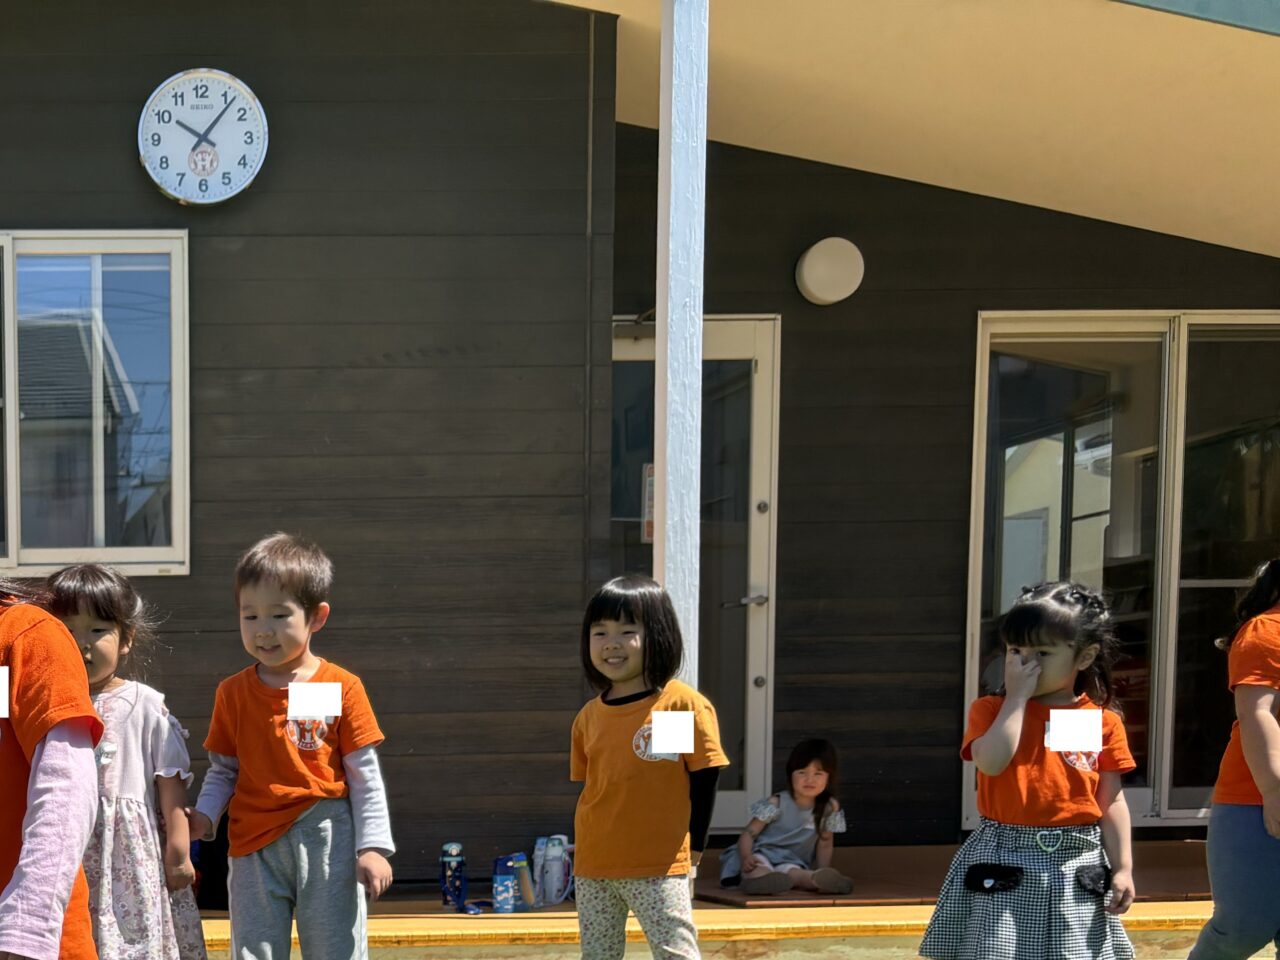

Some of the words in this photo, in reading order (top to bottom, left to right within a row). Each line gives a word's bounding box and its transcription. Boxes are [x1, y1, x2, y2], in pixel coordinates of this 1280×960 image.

[192, 84, 209, 98] 12
[221, 91, 228, 105] 1
[172, 92, 184, 106] 11
[154, 110, 171, 124] 10
[237, 108, 247, 122] 2
[151, 133, 161, 147] 9
[244, 131, 254, 145] 3
[159, 156, 169, 170] 8
[237, 154, 248, 169] 4
[176, 173, 186, 187] 7
[198, 179, 208, 193] 6
[221, 172, 231, 186] 5
